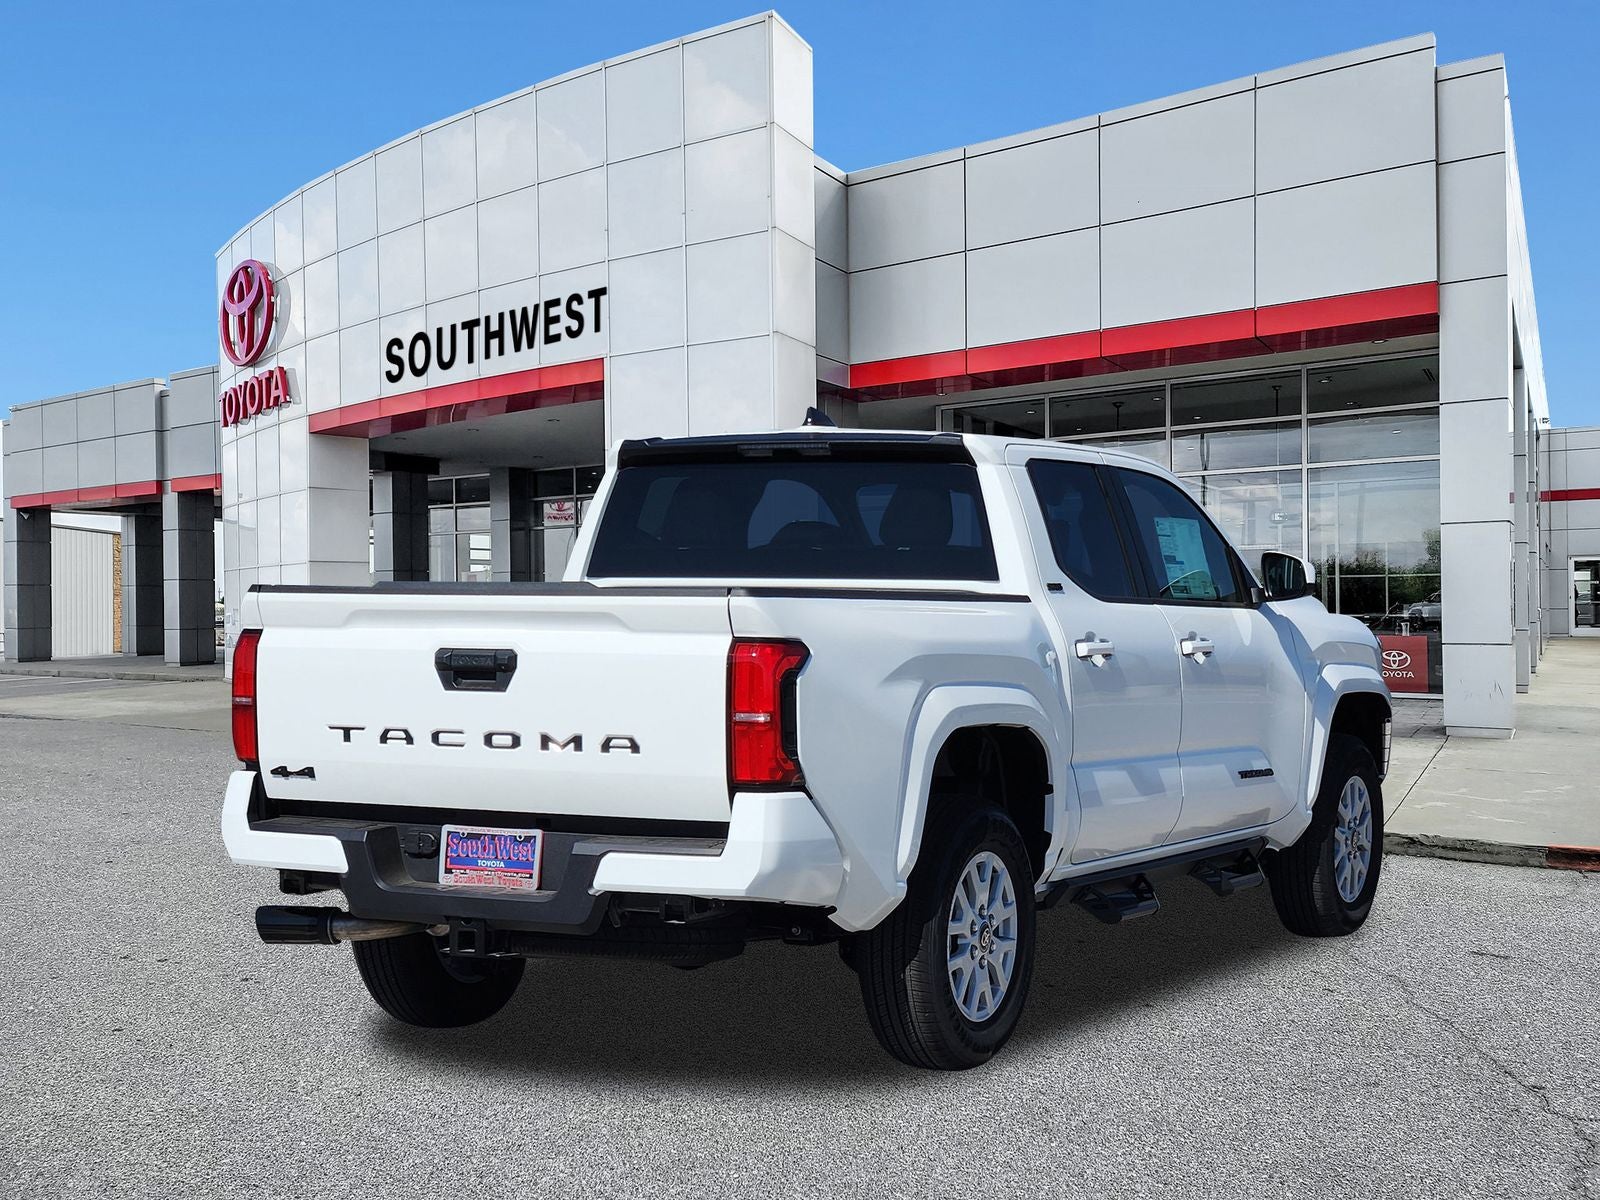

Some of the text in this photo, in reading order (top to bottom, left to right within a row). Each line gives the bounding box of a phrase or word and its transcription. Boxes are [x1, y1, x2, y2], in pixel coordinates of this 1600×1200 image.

[385, 286, 608, 384] SOUTHWEST
[217, 366, 291, 428] TOYOTA
[327, 724, 641, 755] TACOMA
[447, 833, 535, 861] SouthWest
[477, 860, 505, 868] TOYOTA
